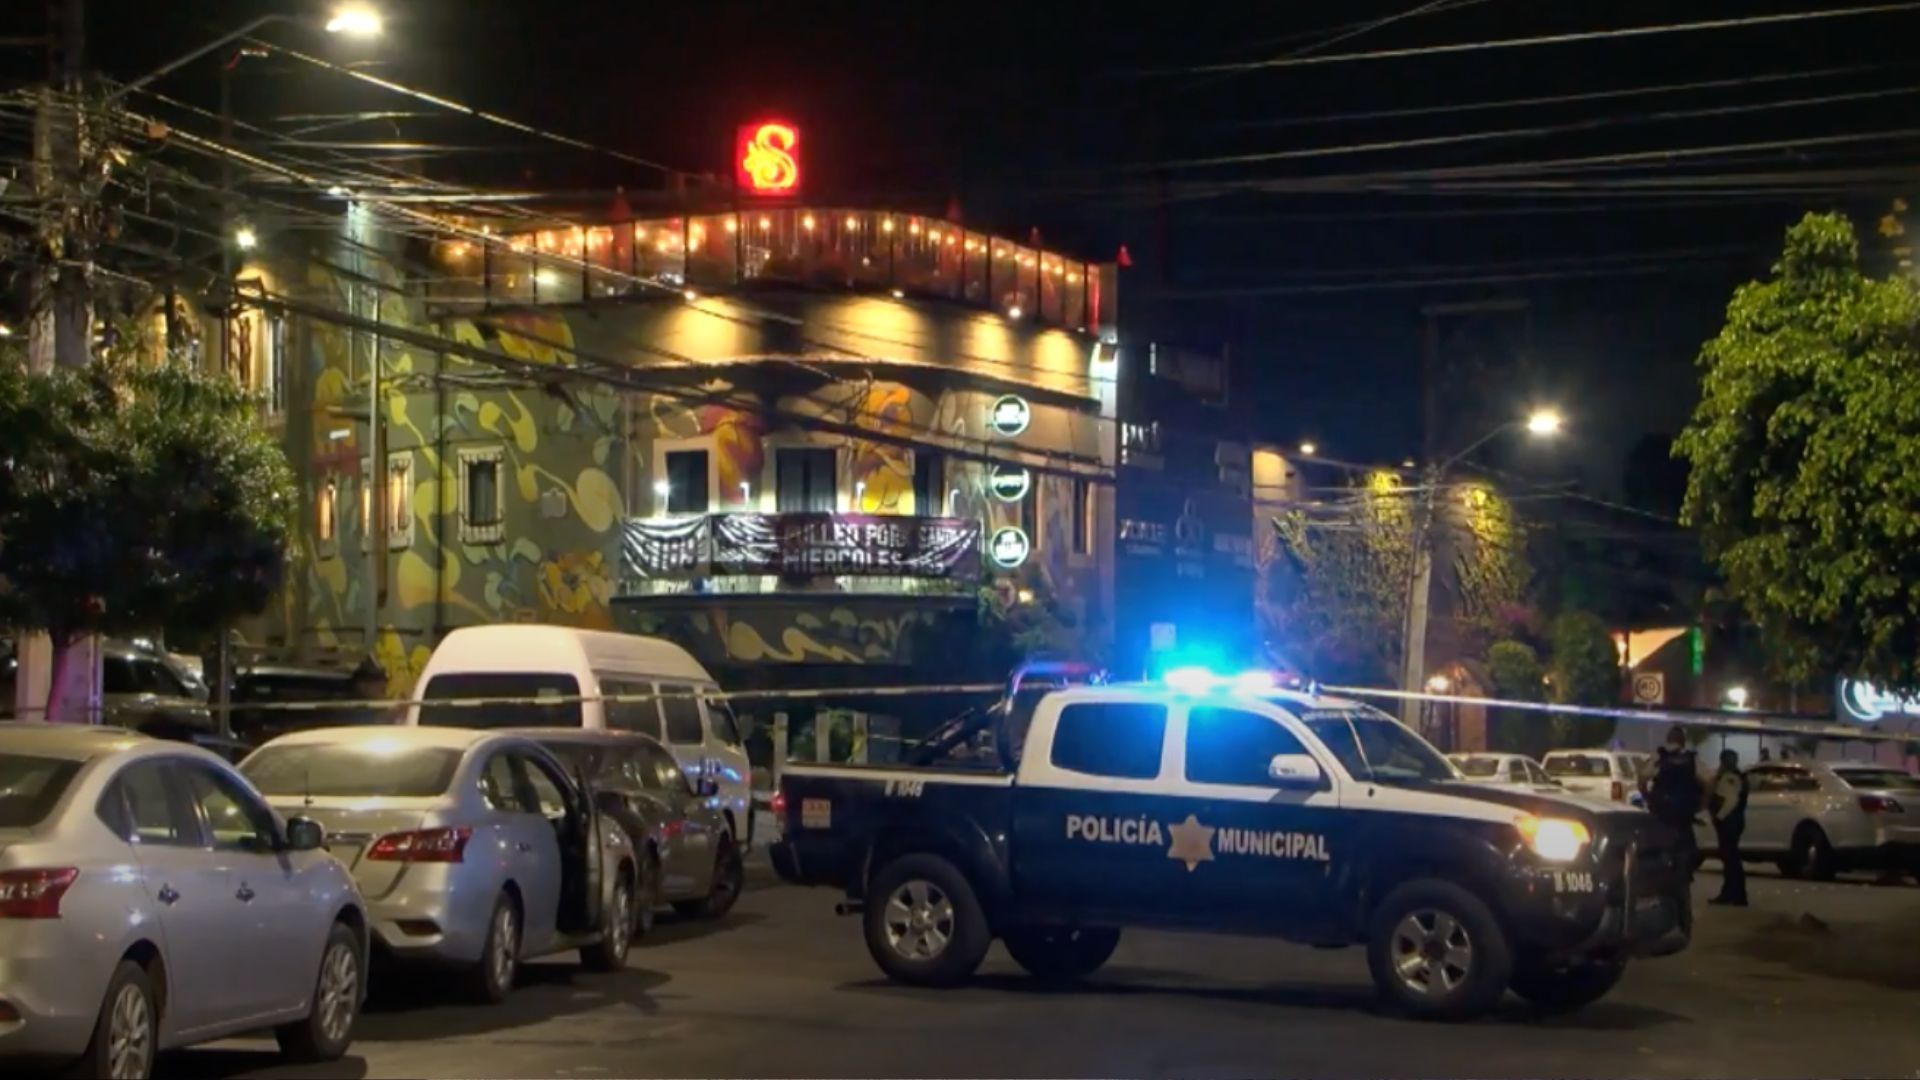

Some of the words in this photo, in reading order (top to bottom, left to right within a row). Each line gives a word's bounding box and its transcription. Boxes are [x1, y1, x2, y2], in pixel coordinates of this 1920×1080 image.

[1067, 814, 1163, 845] POLICÍA
[1218, 828, 1330, 860] MUNICIPAL
[1566, 872, 1593, 892] 1046
